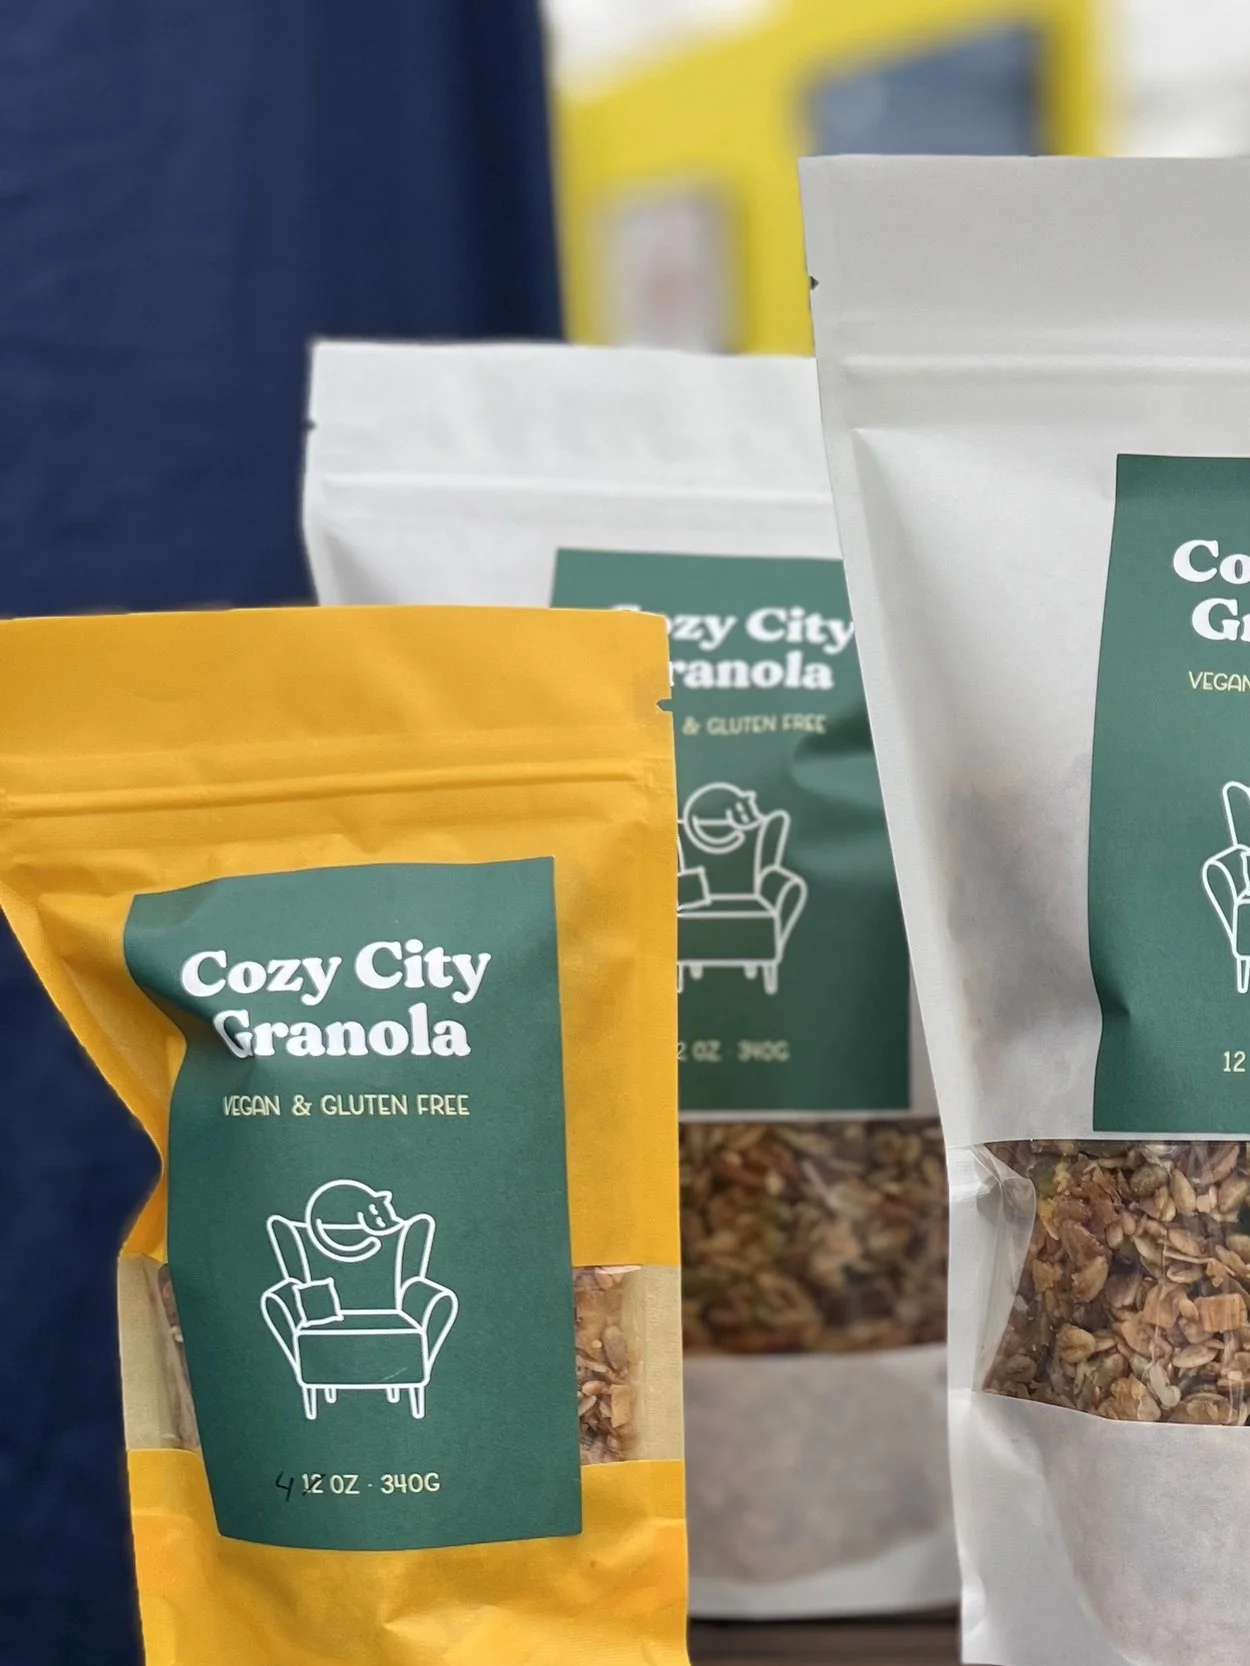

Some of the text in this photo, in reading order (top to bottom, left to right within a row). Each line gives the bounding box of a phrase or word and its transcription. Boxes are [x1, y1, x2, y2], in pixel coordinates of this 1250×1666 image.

[745, 605, 854, 654] City
[669, 650, 834, 690] ranola
[706, 715, 777, 735] GLUTEN
[782, 713, 827, 734] FREE
[180, 938, 492, 1007] Cozy City
[212, 1001, 471, 1060] Granola
[677, 1040, 687, 1061] 2
[1222, 1050, 1246, 1073] 12
[223, 1093, 470, 1117] VEGAN & GLUTEN FREE
[275, 1470, 295, 1502] 4
[329, 1474, 361, 1495] OZ
[380, 1472, 441, 1495] 340G
